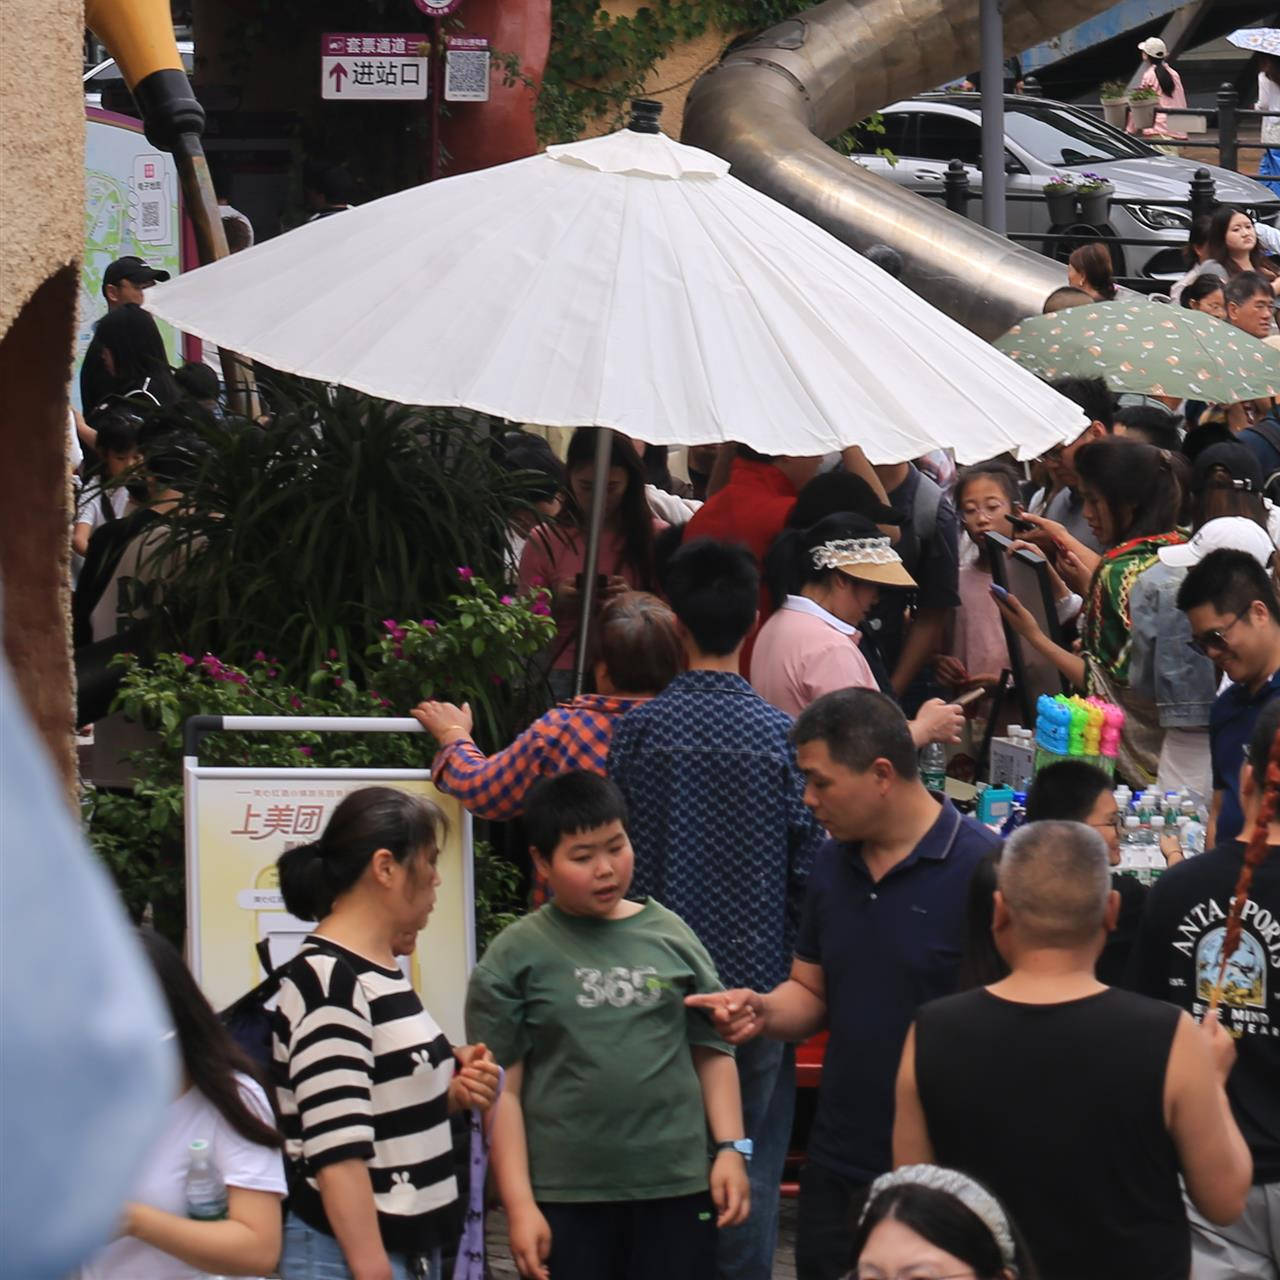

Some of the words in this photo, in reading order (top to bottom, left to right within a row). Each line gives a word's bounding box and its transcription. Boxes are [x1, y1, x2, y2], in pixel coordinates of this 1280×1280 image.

[346, 37, 406, 55] 套票通道
[352, 61, 420, 87] 进站口
[230, 803, 325, 840] 上美团
[1172, 898, 1227, 958] ANTA
[575, 966, 663, 1009] 365
[1231, 1008, 1270, 1024] MIND
